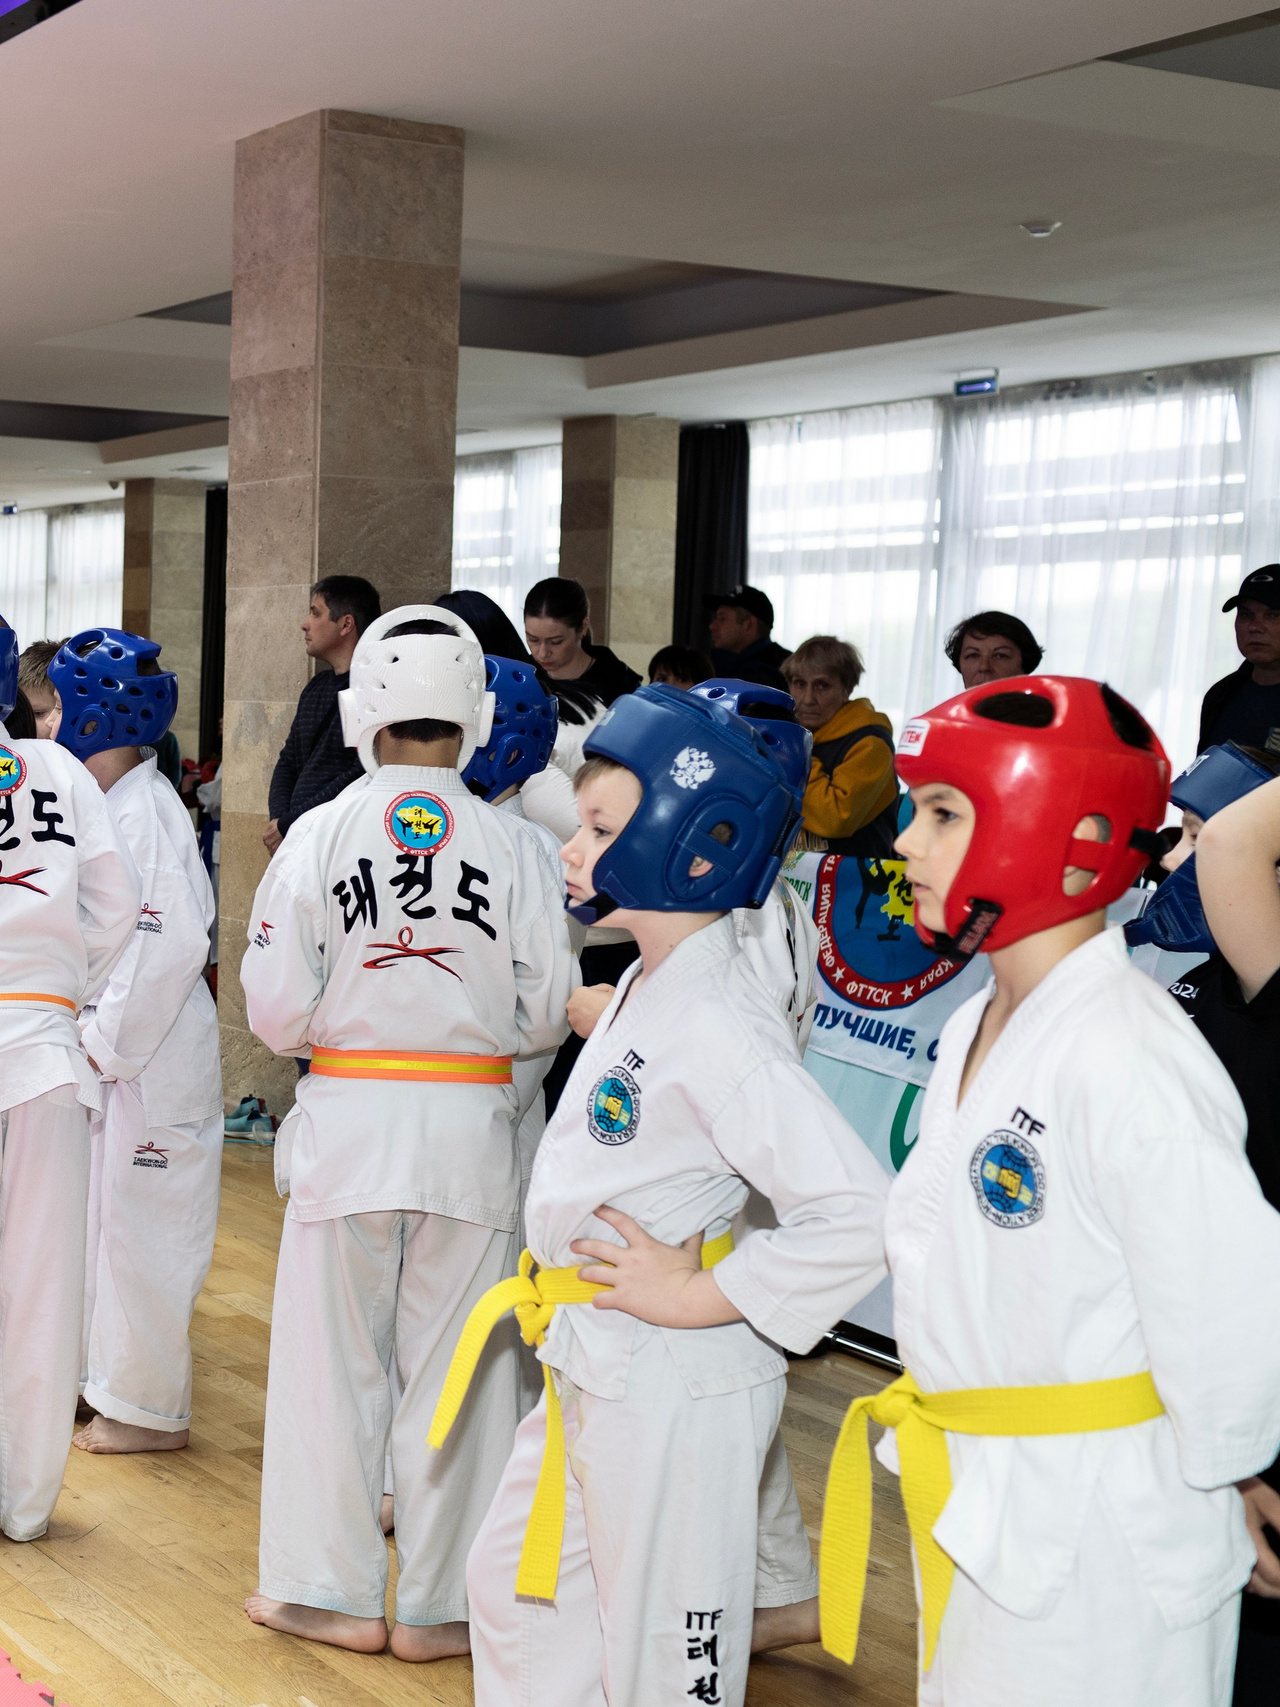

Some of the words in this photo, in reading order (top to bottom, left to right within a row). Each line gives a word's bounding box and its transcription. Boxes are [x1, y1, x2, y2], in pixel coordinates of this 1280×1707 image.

[332, 853, 497, 942] 태권도
[818, 883, 836, 968] ФЕДЕРАЦИЯ
[920, 957, 955, 990] КРАЯ
[846, 980, 893, 1006] ФТТСК
[813, 1002, 917, 1060] ЛУЧШИЕ,
[622, 1048, 646, 1071] ITF
[1010, 1105, 1046, 1136] ITF
[685, 1608, 724, 1631] ITF
